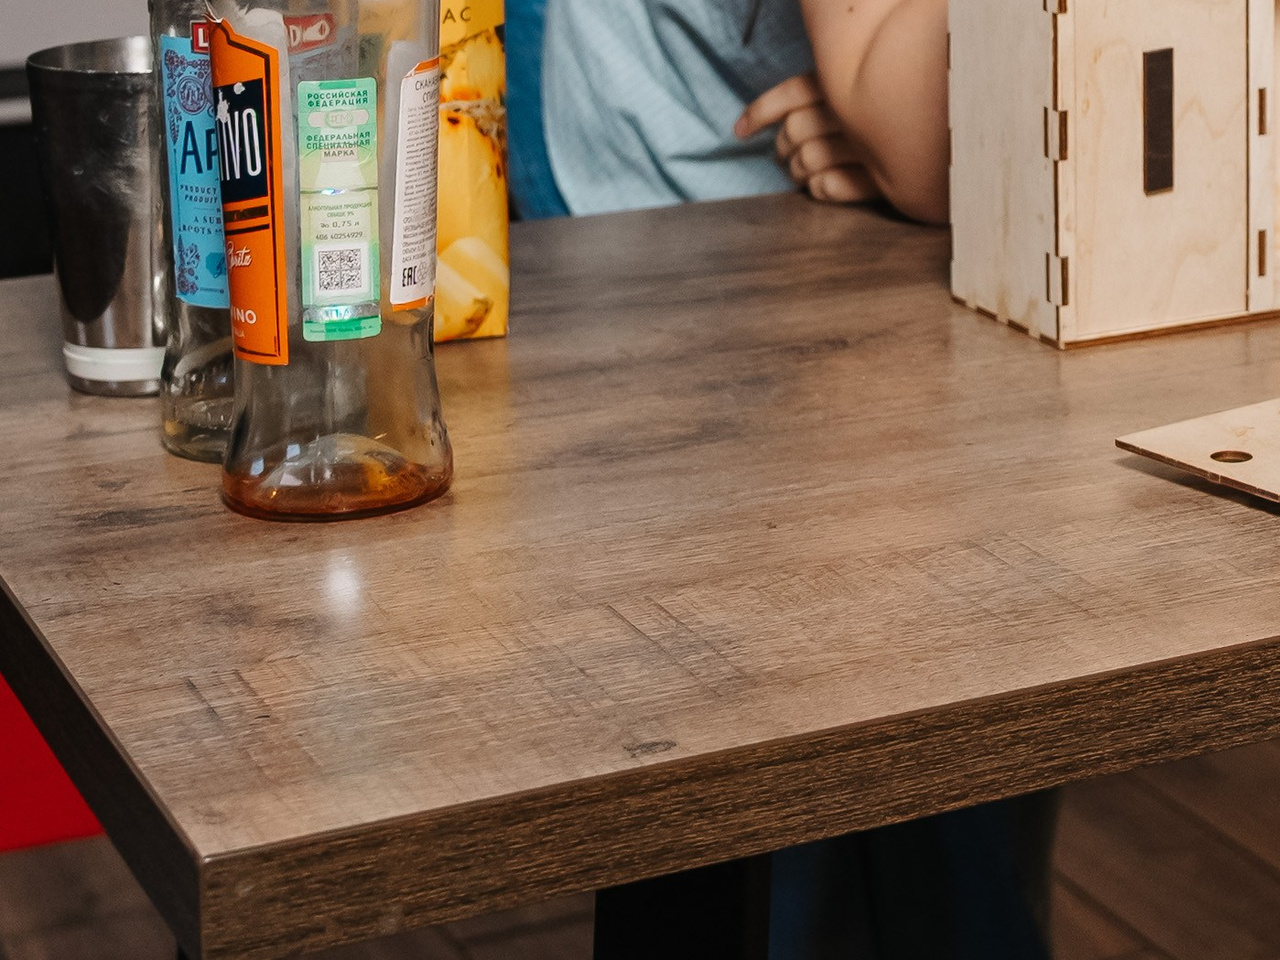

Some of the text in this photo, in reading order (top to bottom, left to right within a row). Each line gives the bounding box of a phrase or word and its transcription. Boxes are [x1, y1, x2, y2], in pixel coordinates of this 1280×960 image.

[307, 90, 368, 100] РОССИЙСКАЯ
[307, 98, 368, 107] ФЕДЕРАЦИЯ
[306, 131, 371, 142] ФЕДЕРАЛЬНАЯ
[306, 139, 371, 150] СПЕЦИАЛЬНАЯ
[180, 185, 217, 194] PRODUCT
